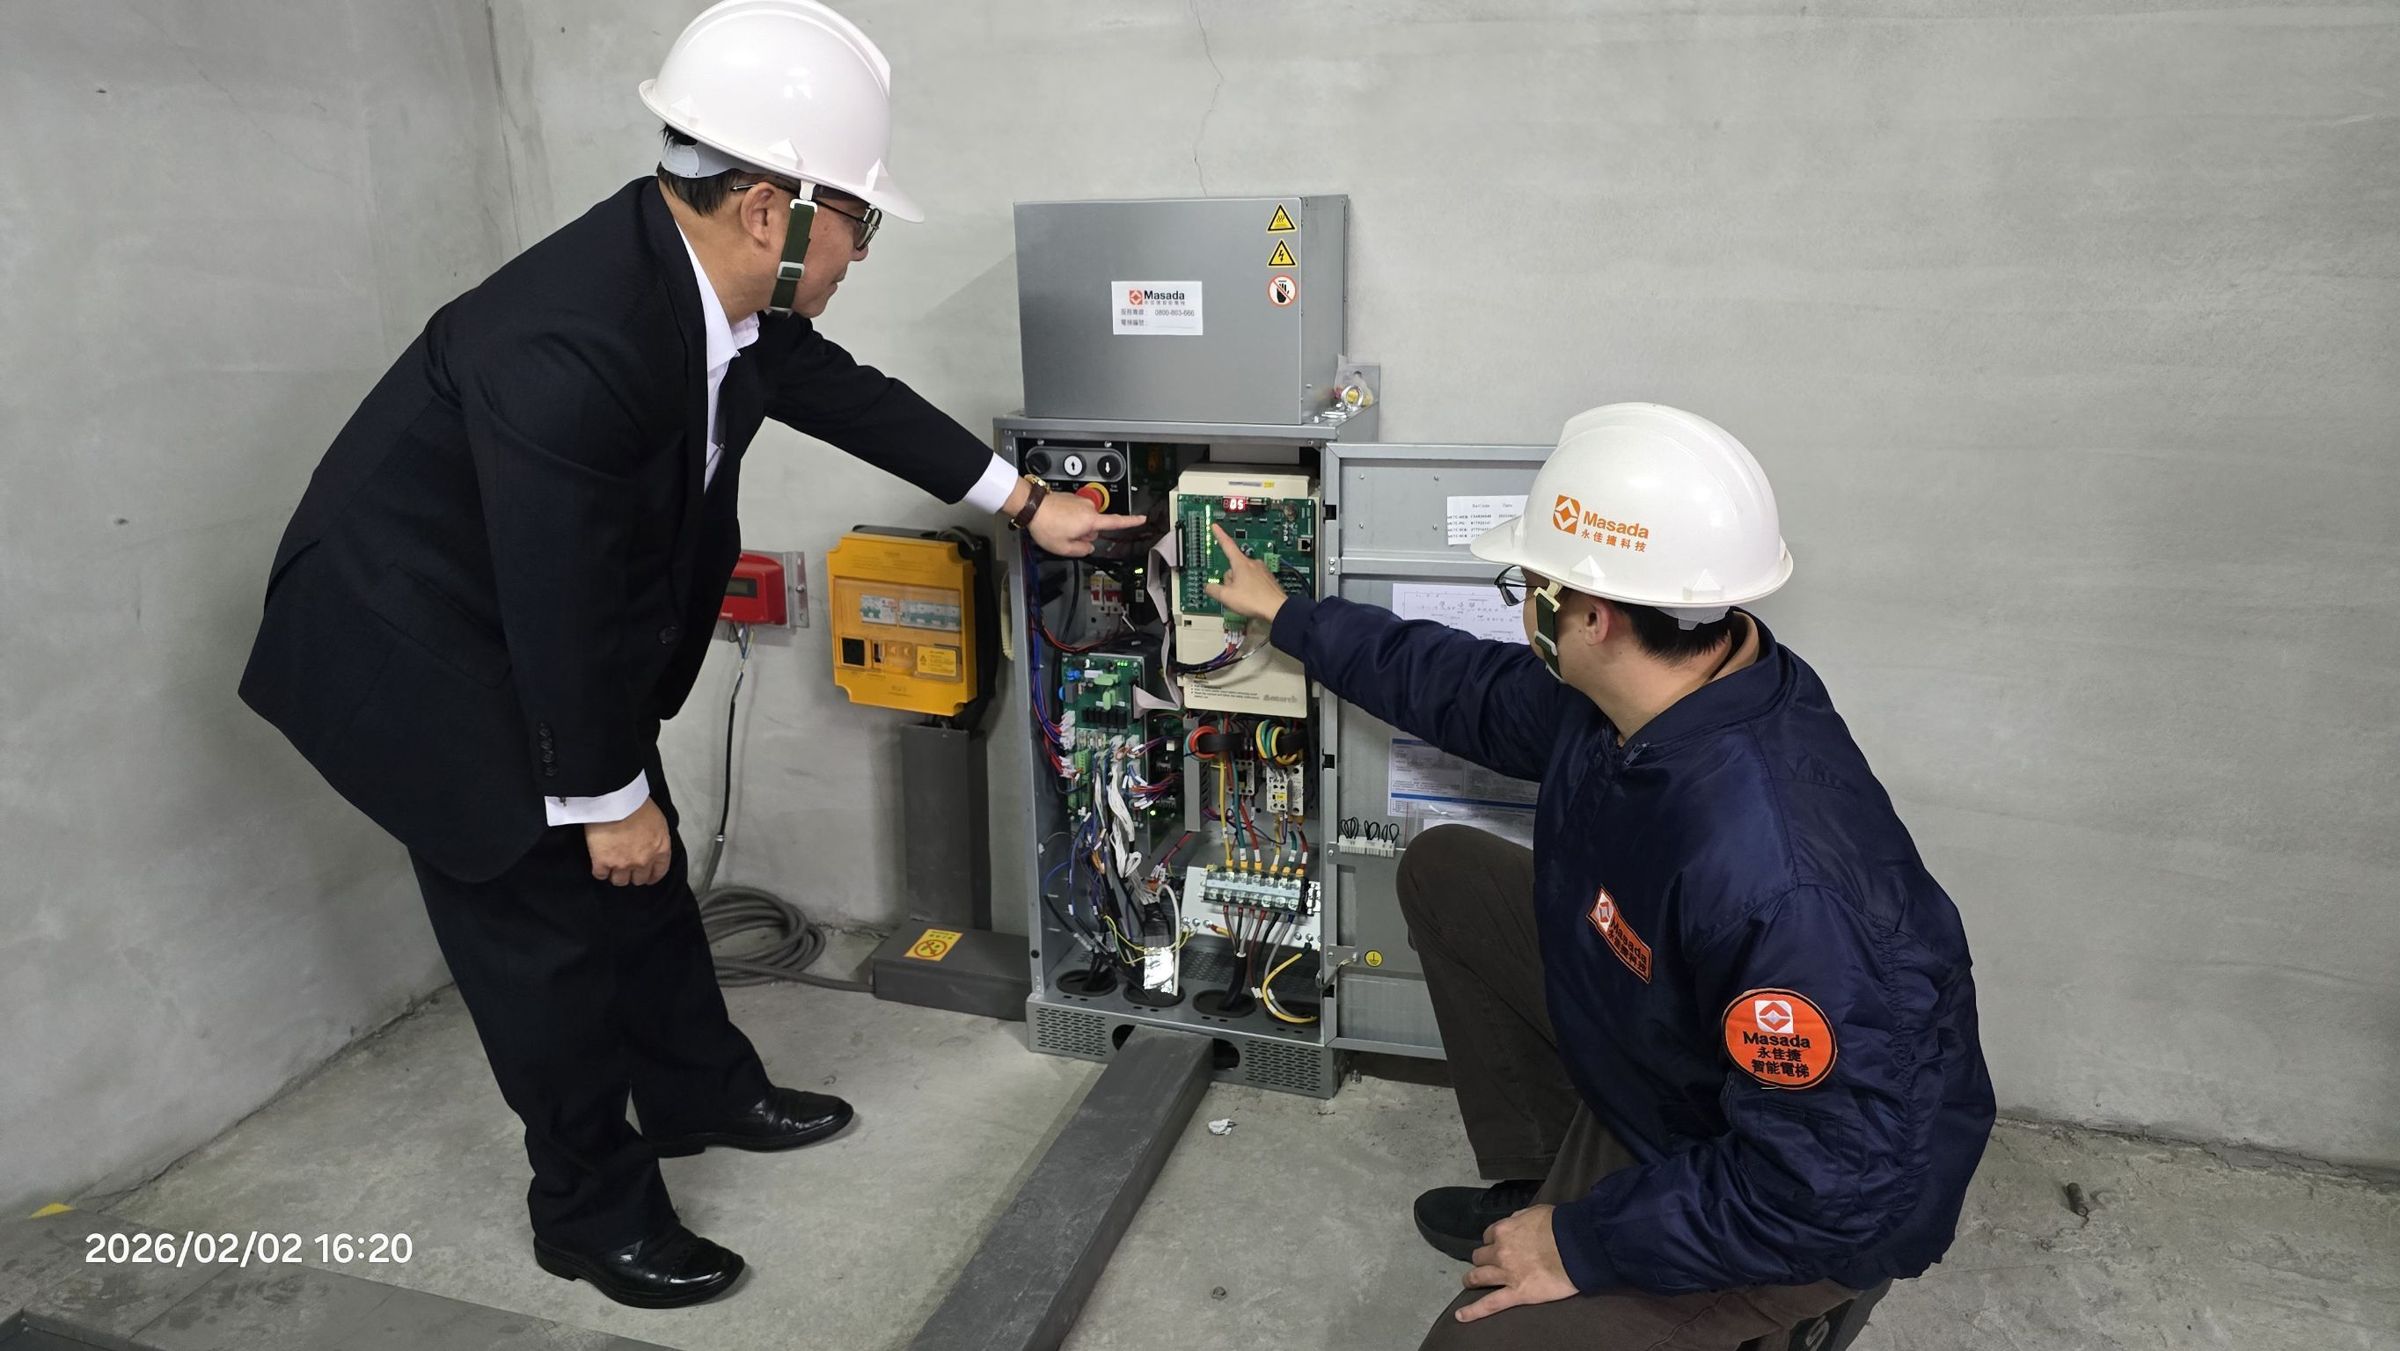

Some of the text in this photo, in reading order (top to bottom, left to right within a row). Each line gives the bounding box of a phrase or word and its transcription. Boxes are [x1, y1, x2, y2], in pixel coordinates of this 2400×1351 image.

[1144, 290, 1185, 300] Masada
[1583, 510, 1649, 539] Masada
[1581, 528, 1647, 553] 永佳捷科技
[1610, 915, 1647, 964] Masada
[1743, 1031, 1811, 1049] Masada
[1757, 1046, 1802, 1062] 永佳捷
[1751, 1059, 1810, 1078] 智能電梯
